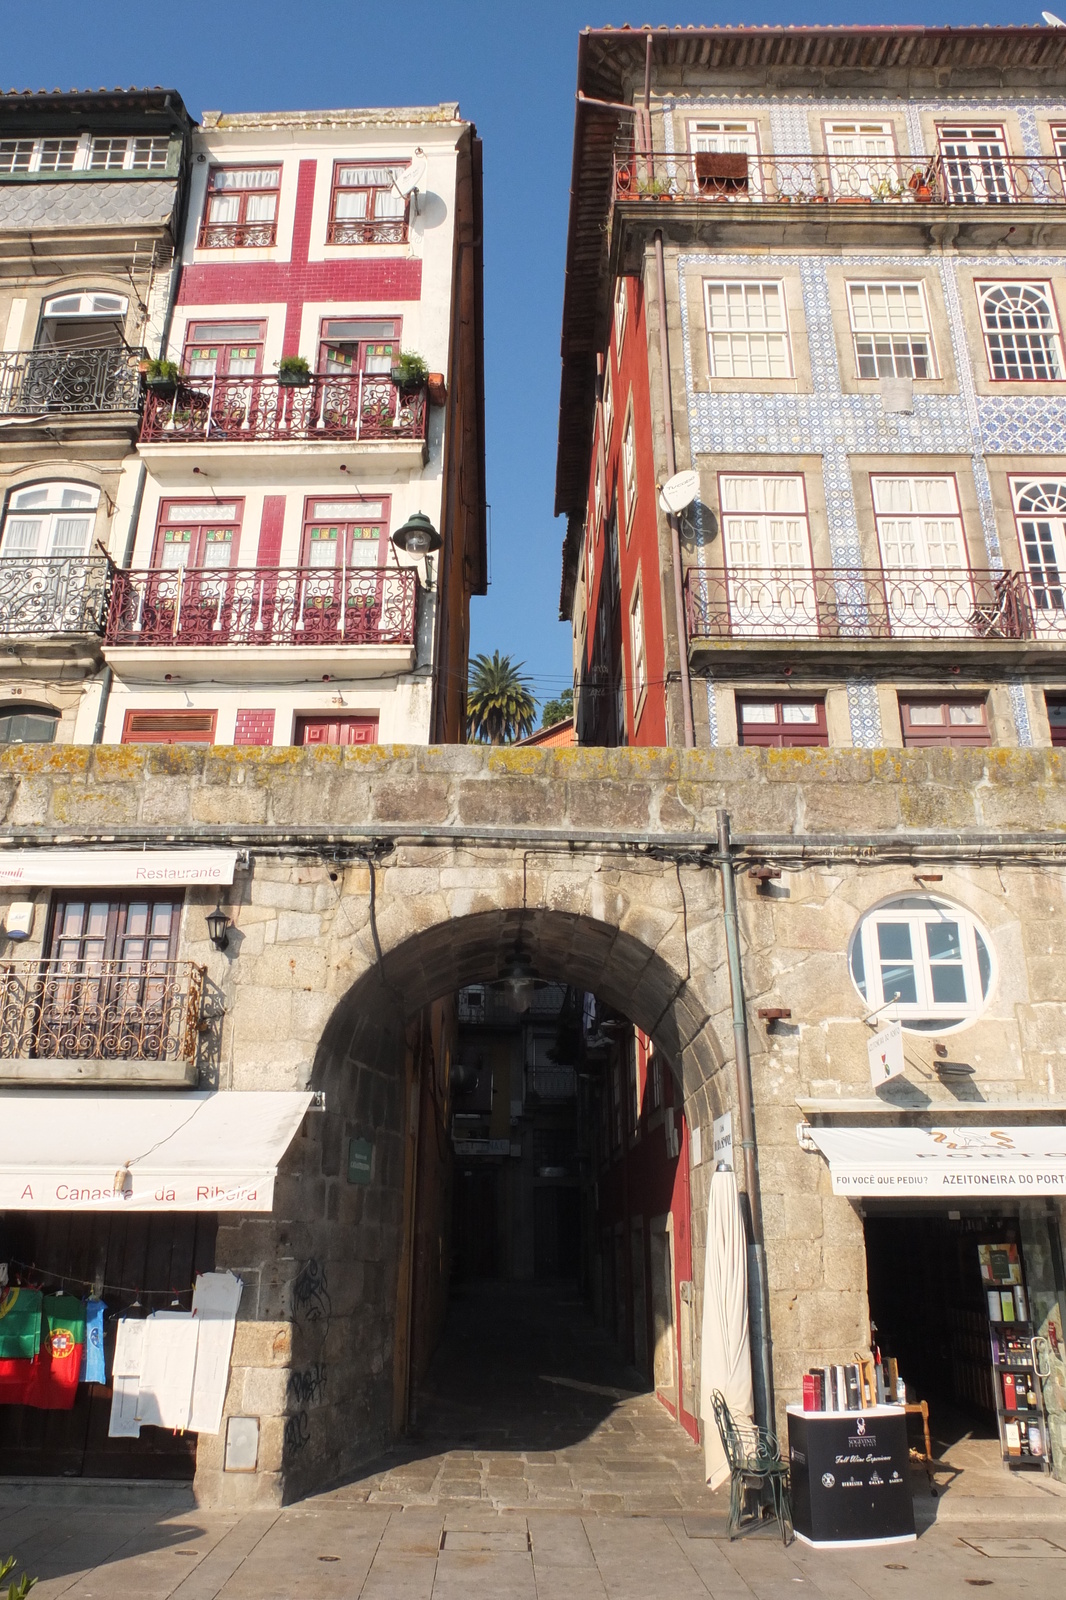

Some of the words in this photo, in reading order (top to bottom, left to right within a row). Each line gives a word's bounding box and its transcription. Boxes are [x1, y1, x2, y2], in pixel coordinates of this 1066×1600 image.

[136, 867, 221, 879] Restaurante
[836, 1176, 850, 1184] FOI
[852, 1174, 875, 1184] VOCÊ
[877, 1176, 895, 1185] QUE
[897, 1176, 928, 1184] PEDIU?
[942, 1175, 1016, 1184] AZEITONEIRA
[1018, 1174, 1034, 1184] DO
[1036, 1174, 1066, 1184] PORT
[21, 1185, 34, 1200] A
[154, 1186, 176, 1201] da
[196, 1186, 257, 1201] Ribeira
